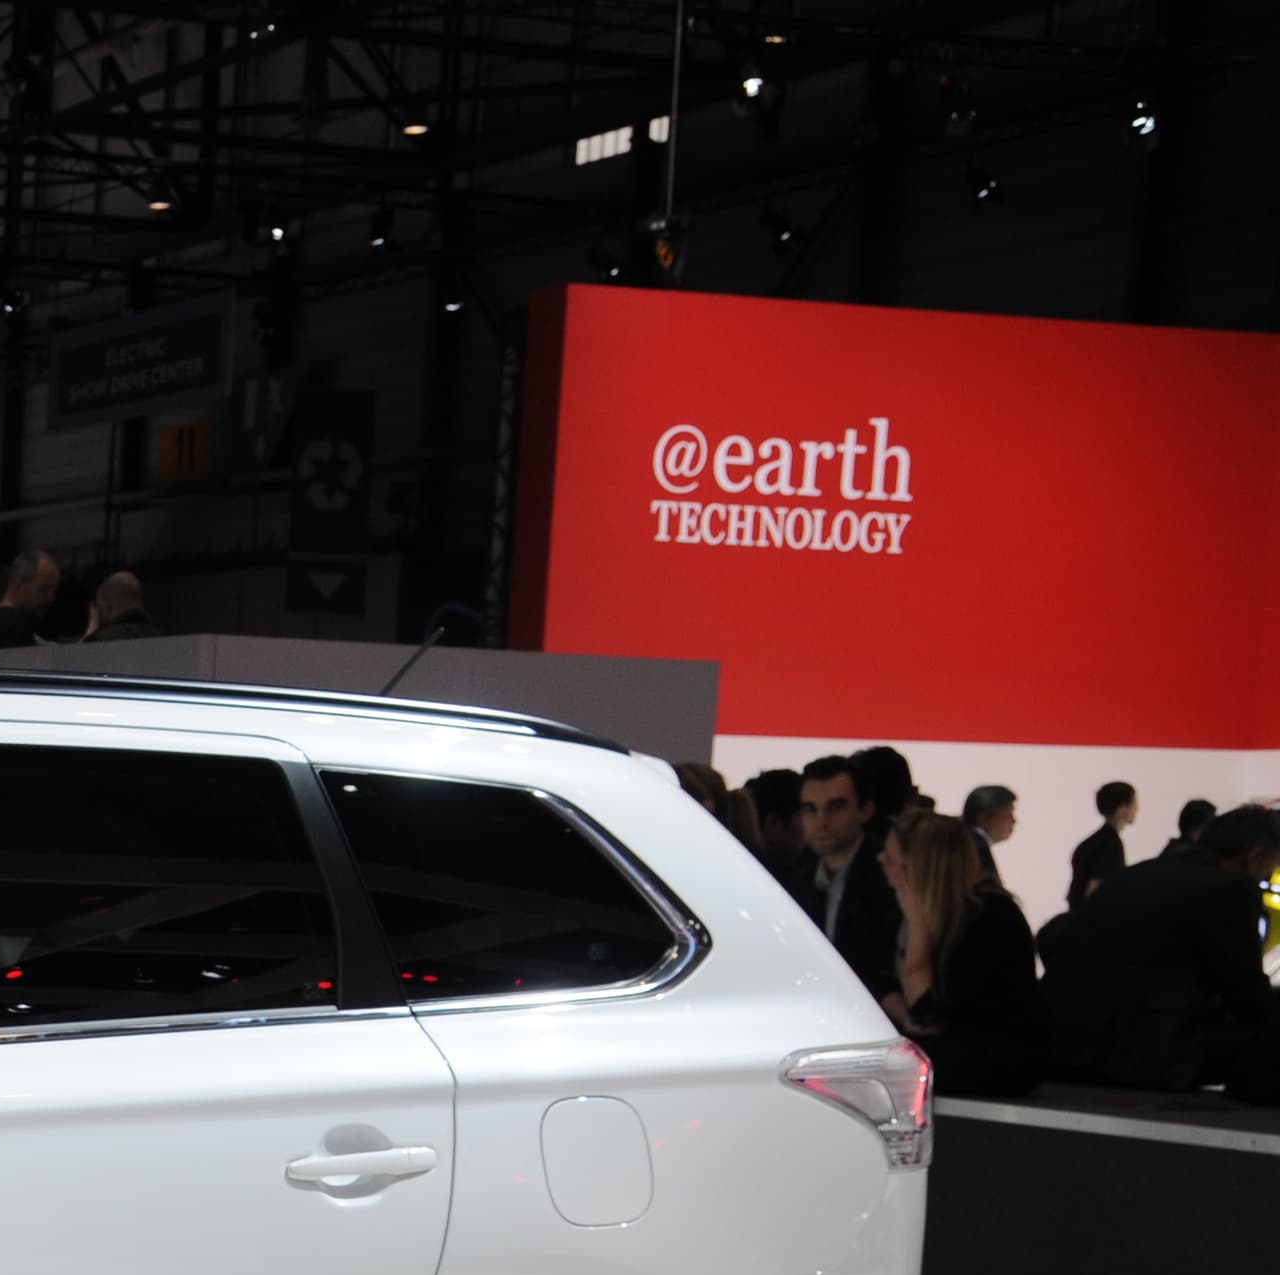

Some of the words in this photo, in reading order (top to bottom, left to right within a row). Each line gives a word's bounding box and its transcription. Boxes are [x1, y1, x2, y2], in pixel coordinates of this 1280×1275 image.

[152, 356, 206, 385] CENTER
[652, 417, 913, 502] @earth
[650, 500, 913, 554] TECHNOLOGY
